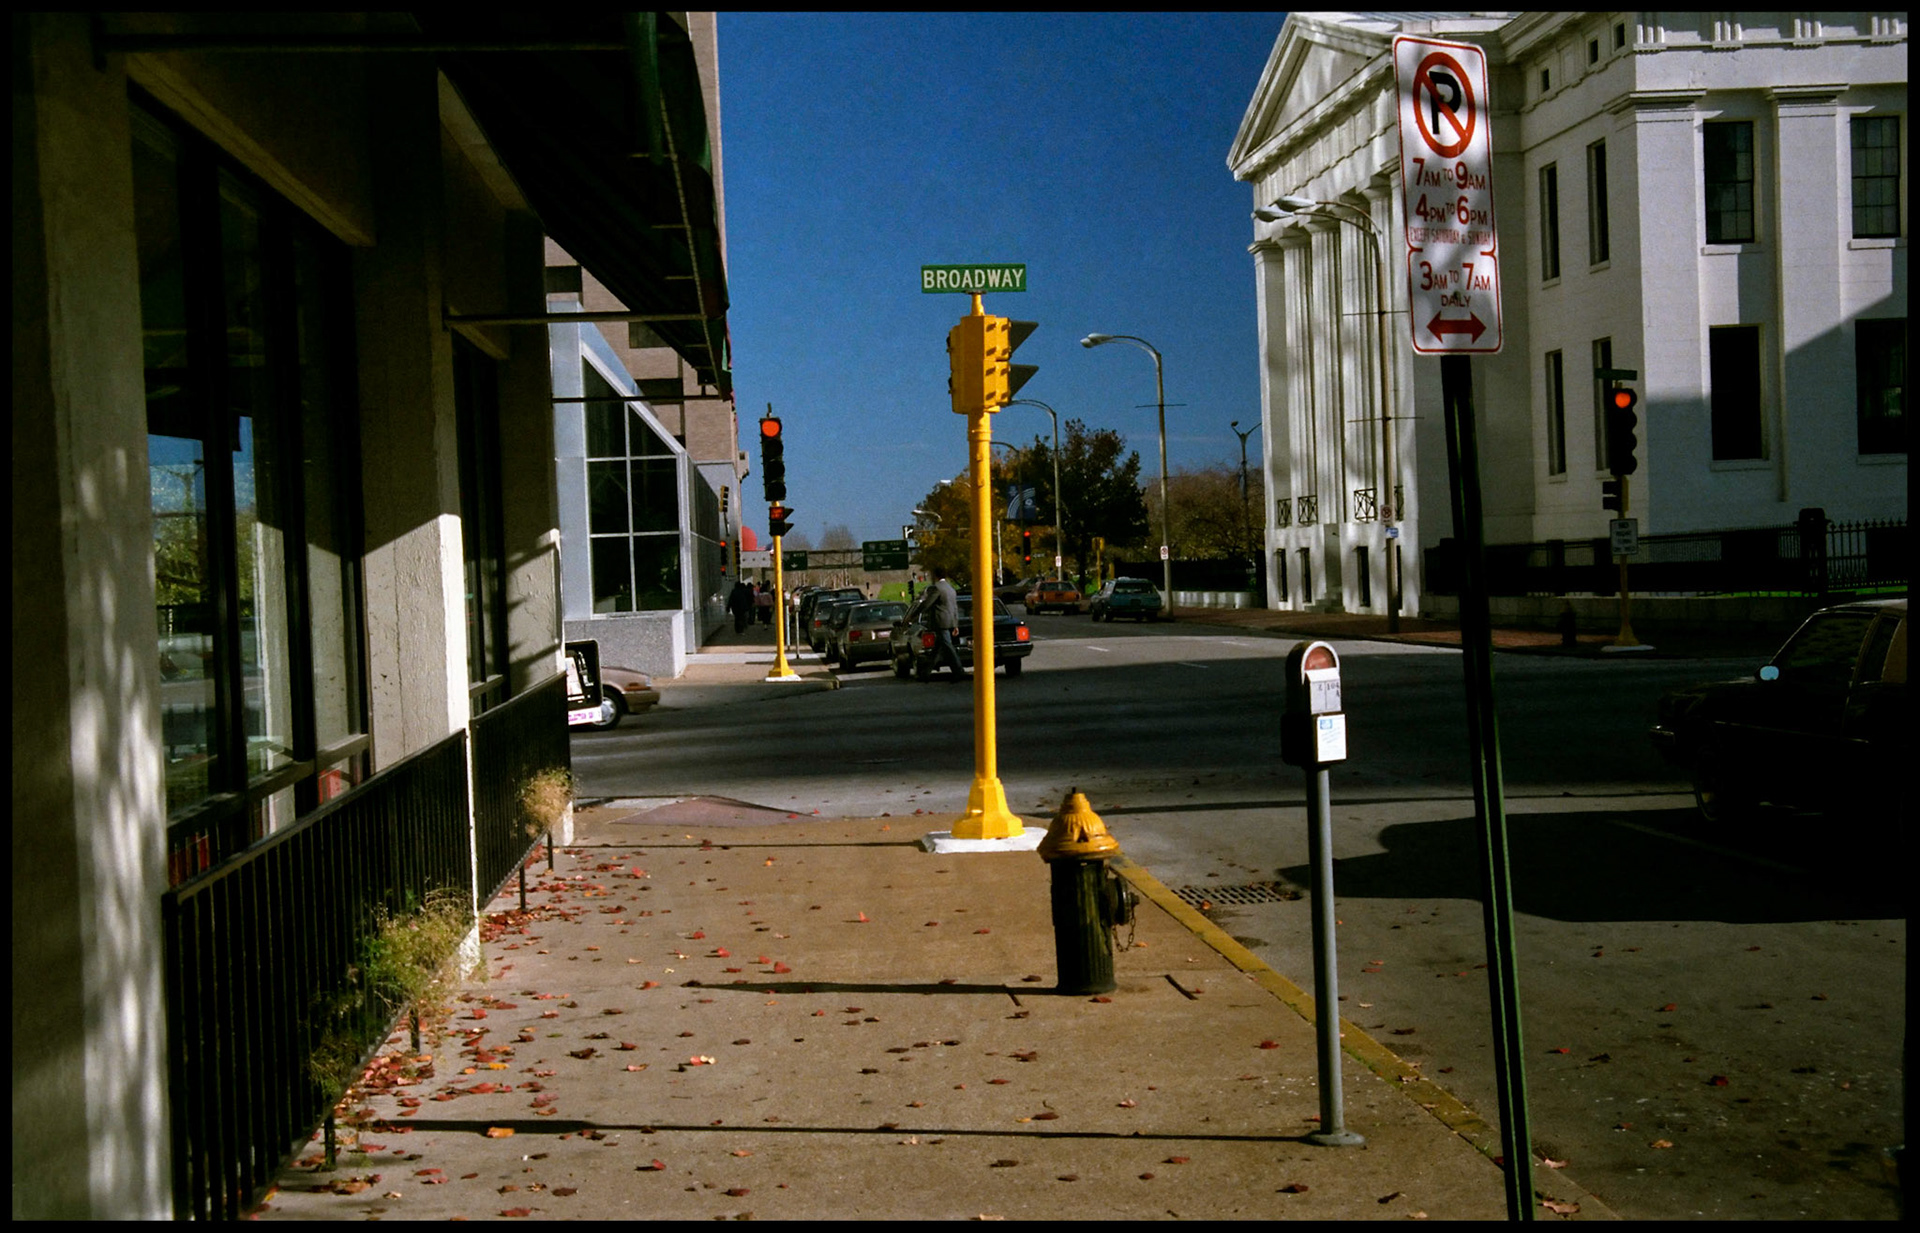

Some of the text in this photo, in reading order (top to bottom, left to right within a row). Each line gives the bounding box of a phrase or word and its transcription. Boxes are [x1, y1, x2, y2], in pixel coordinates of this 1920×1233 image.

[1412, 157, 1486, 190] 7AM TO 9AM
[1415, 193, 1488, 227] 4PM TO 6PM
[1410, 227, 1430, 242] EXCEPT
[1432, 228, 1460, 244] SATURDAY
[1467, 231, 1490, 246] SUNDAY
[923, 268, 1024, 289] BROADWAY
[1419, 260, 1491, 291] 3AM TO 7AM
[1440, 294, 1471, 308] DAILY
